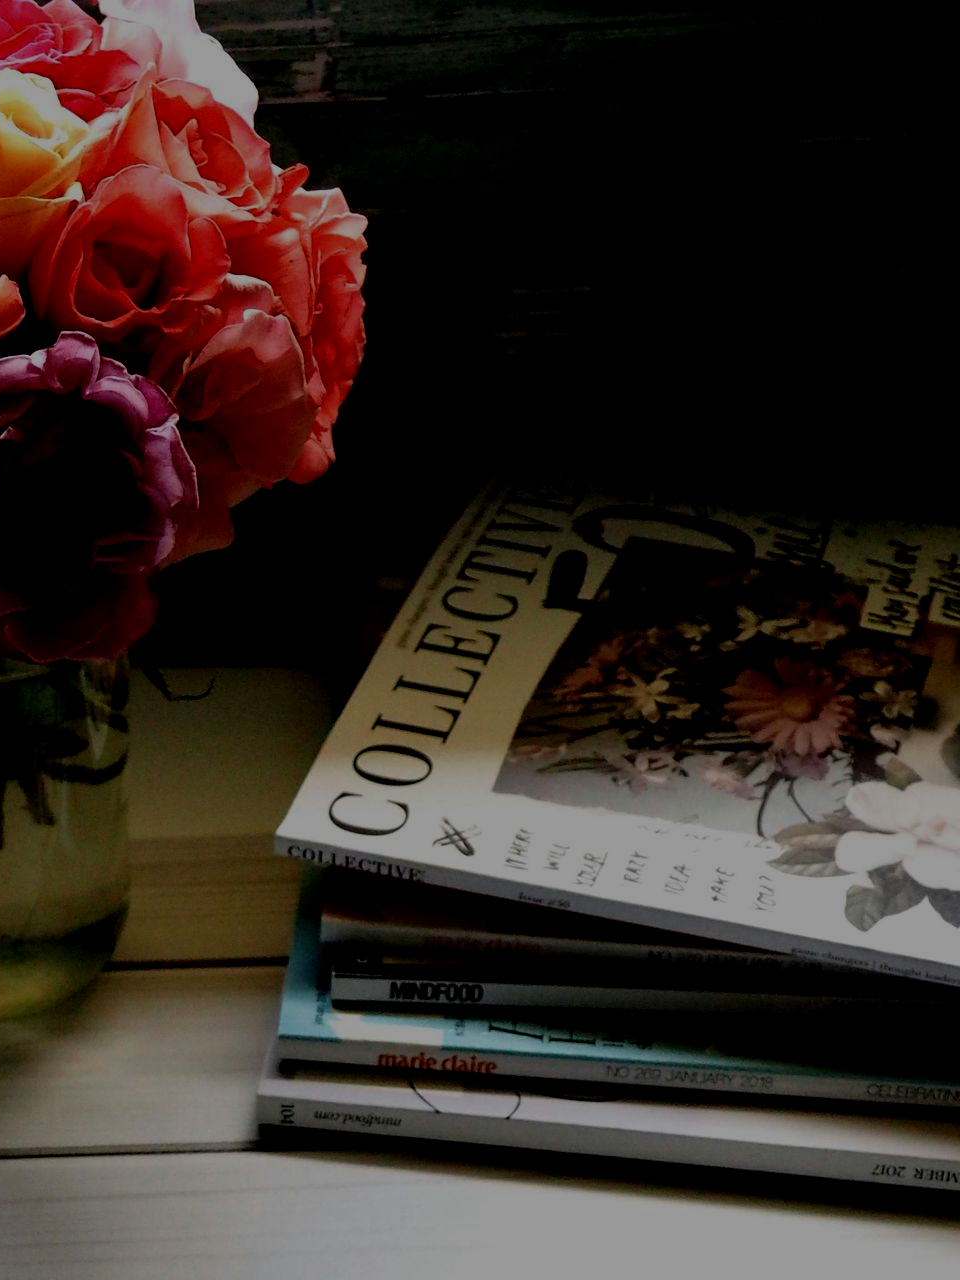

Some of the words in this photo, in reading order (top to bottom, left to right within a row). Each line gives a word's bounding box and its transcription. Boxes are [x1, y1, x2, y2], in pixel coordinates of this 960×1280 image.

[287, 844, 426, 882] COLLECTIVE
[619, 851, 649, 888] RAZY
[389, 982, 484, 1002] MINDFOOD
[377, 1052, 437, 1070] marie
[440, 1055, 498, 1074] claire
[607, 1066, 629, 1079] NO
[666, 1069, 736, 1086] JANUARY
[313, 1110, 402, 1127] mindfood.com
[872, 1164, 906, 1177] 2017
